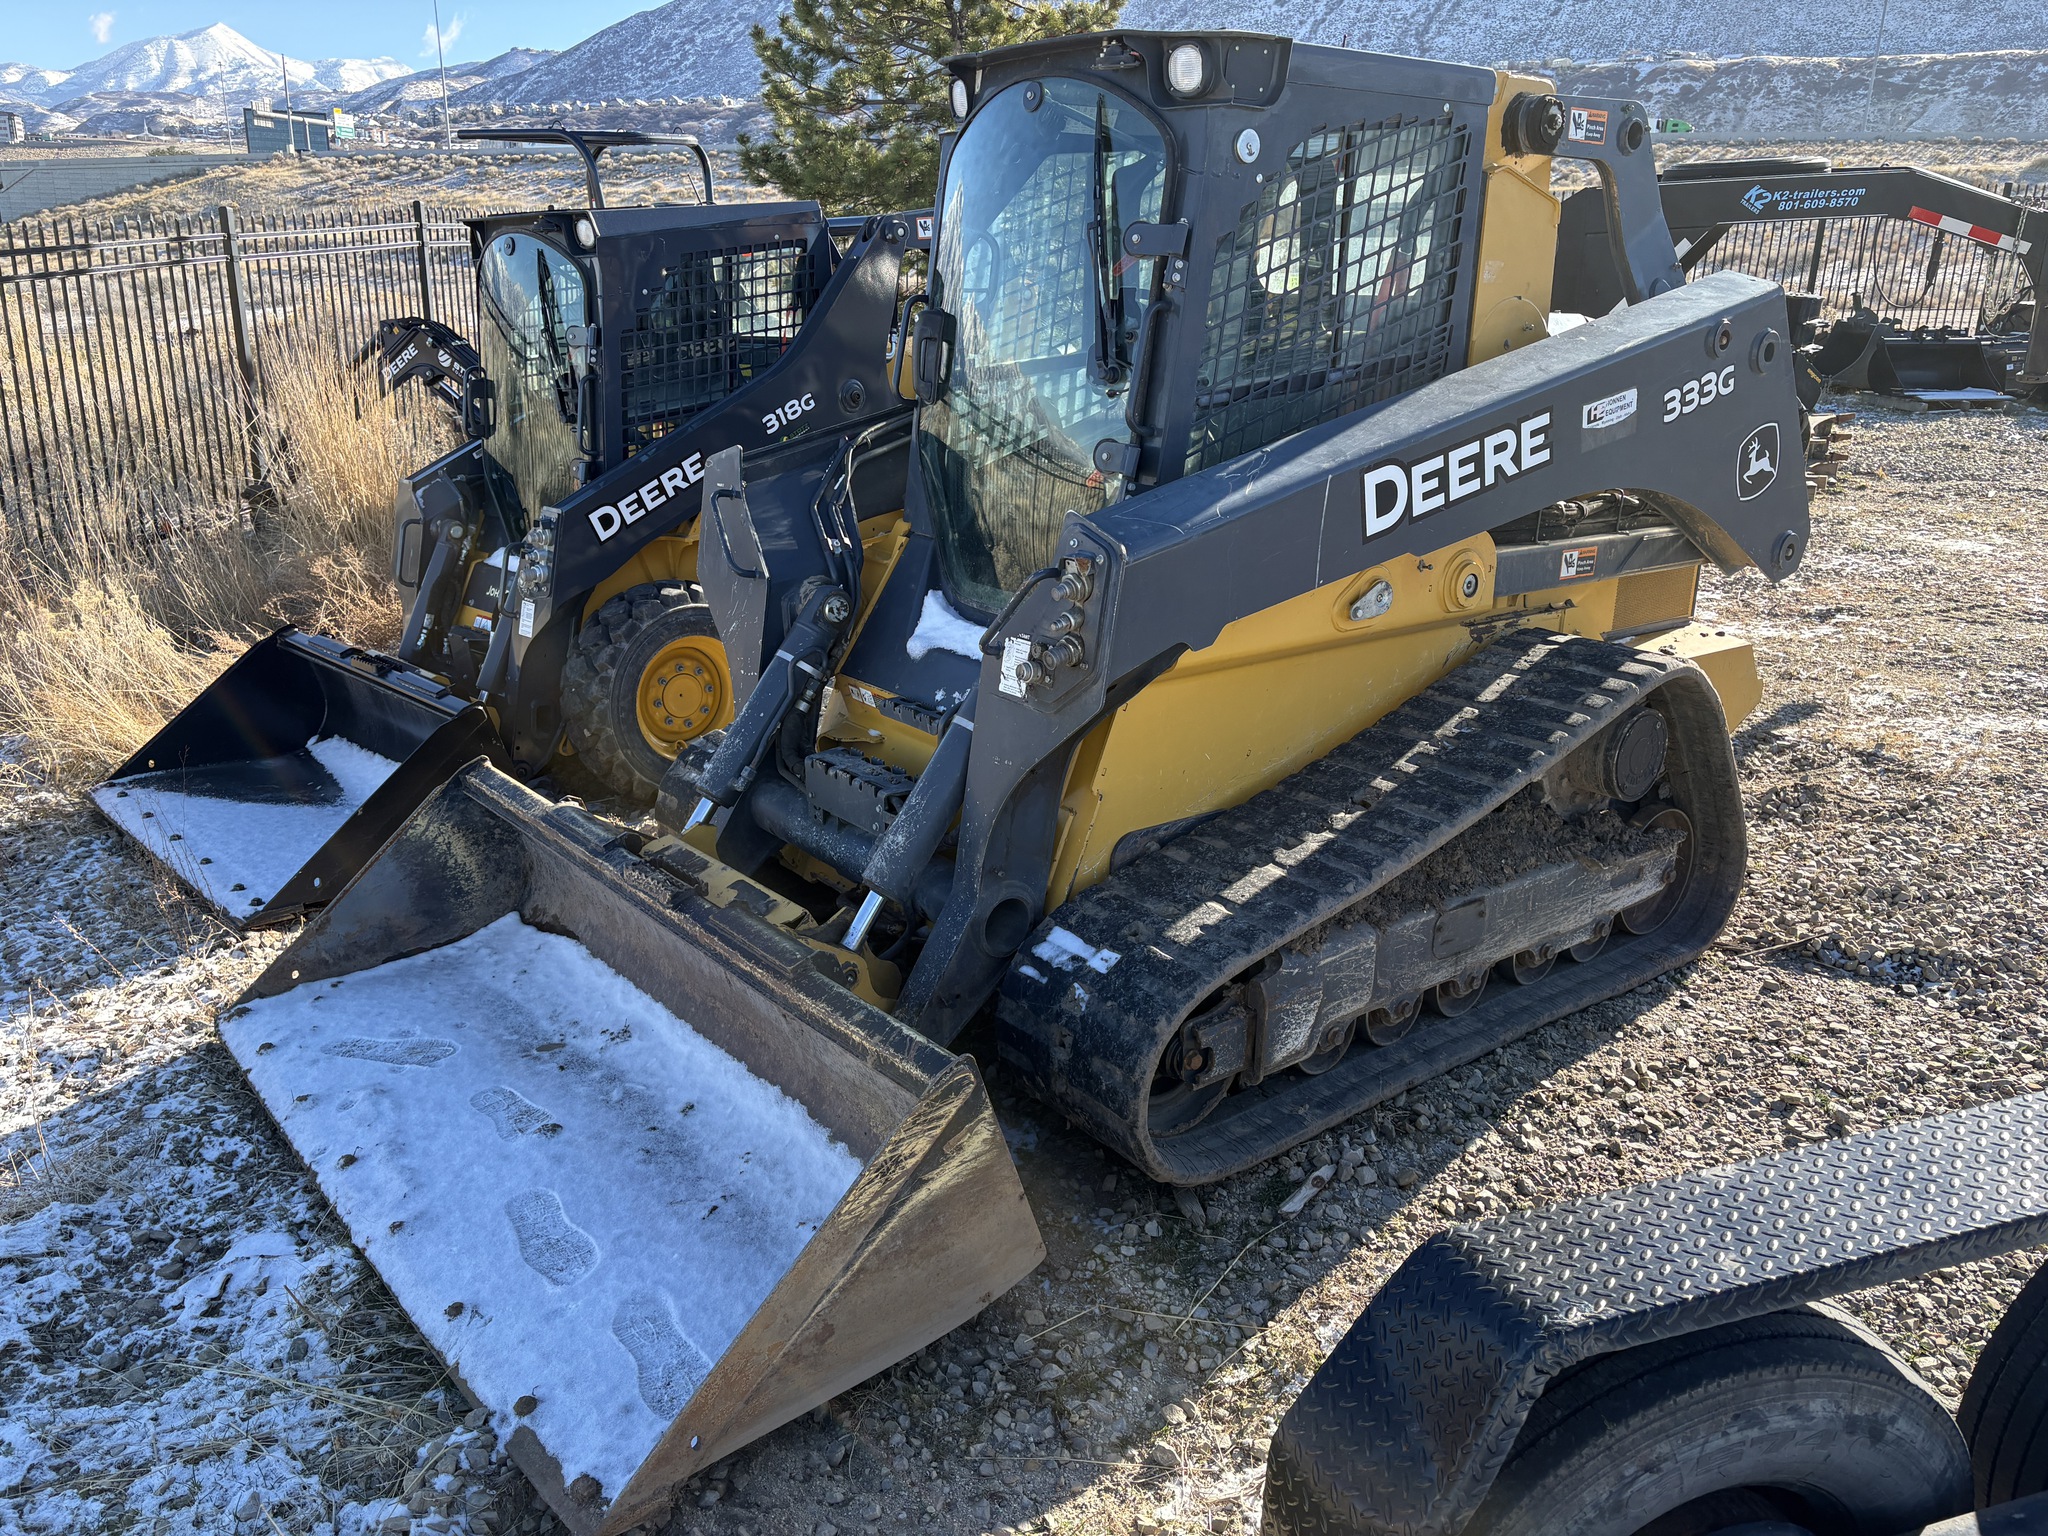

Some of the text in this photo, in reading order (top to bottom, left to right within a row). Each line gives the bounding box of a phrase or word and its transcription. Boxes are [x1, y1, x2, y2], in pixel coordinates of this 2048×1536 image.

[1740, 199, 1760, 215] TRAILERS
[1744, 184, 1772, 210] K2
[1773, 188, 1866, 201] K2-trailers.com
[1778, 197, 1859, 211] 801-609-8570
[381, 343, 419, 381] DEERE
[1605, 394, 1627, 407] HONNEN
[1663, 365, 1735, 422] 333G
[761, 392, 816, 435] 318G
[1605, 401, 1633, 416] EQUIPMENT
[1364, 412, 1550, 537] DEERE
[588, 452, 705, 542] DEERE
